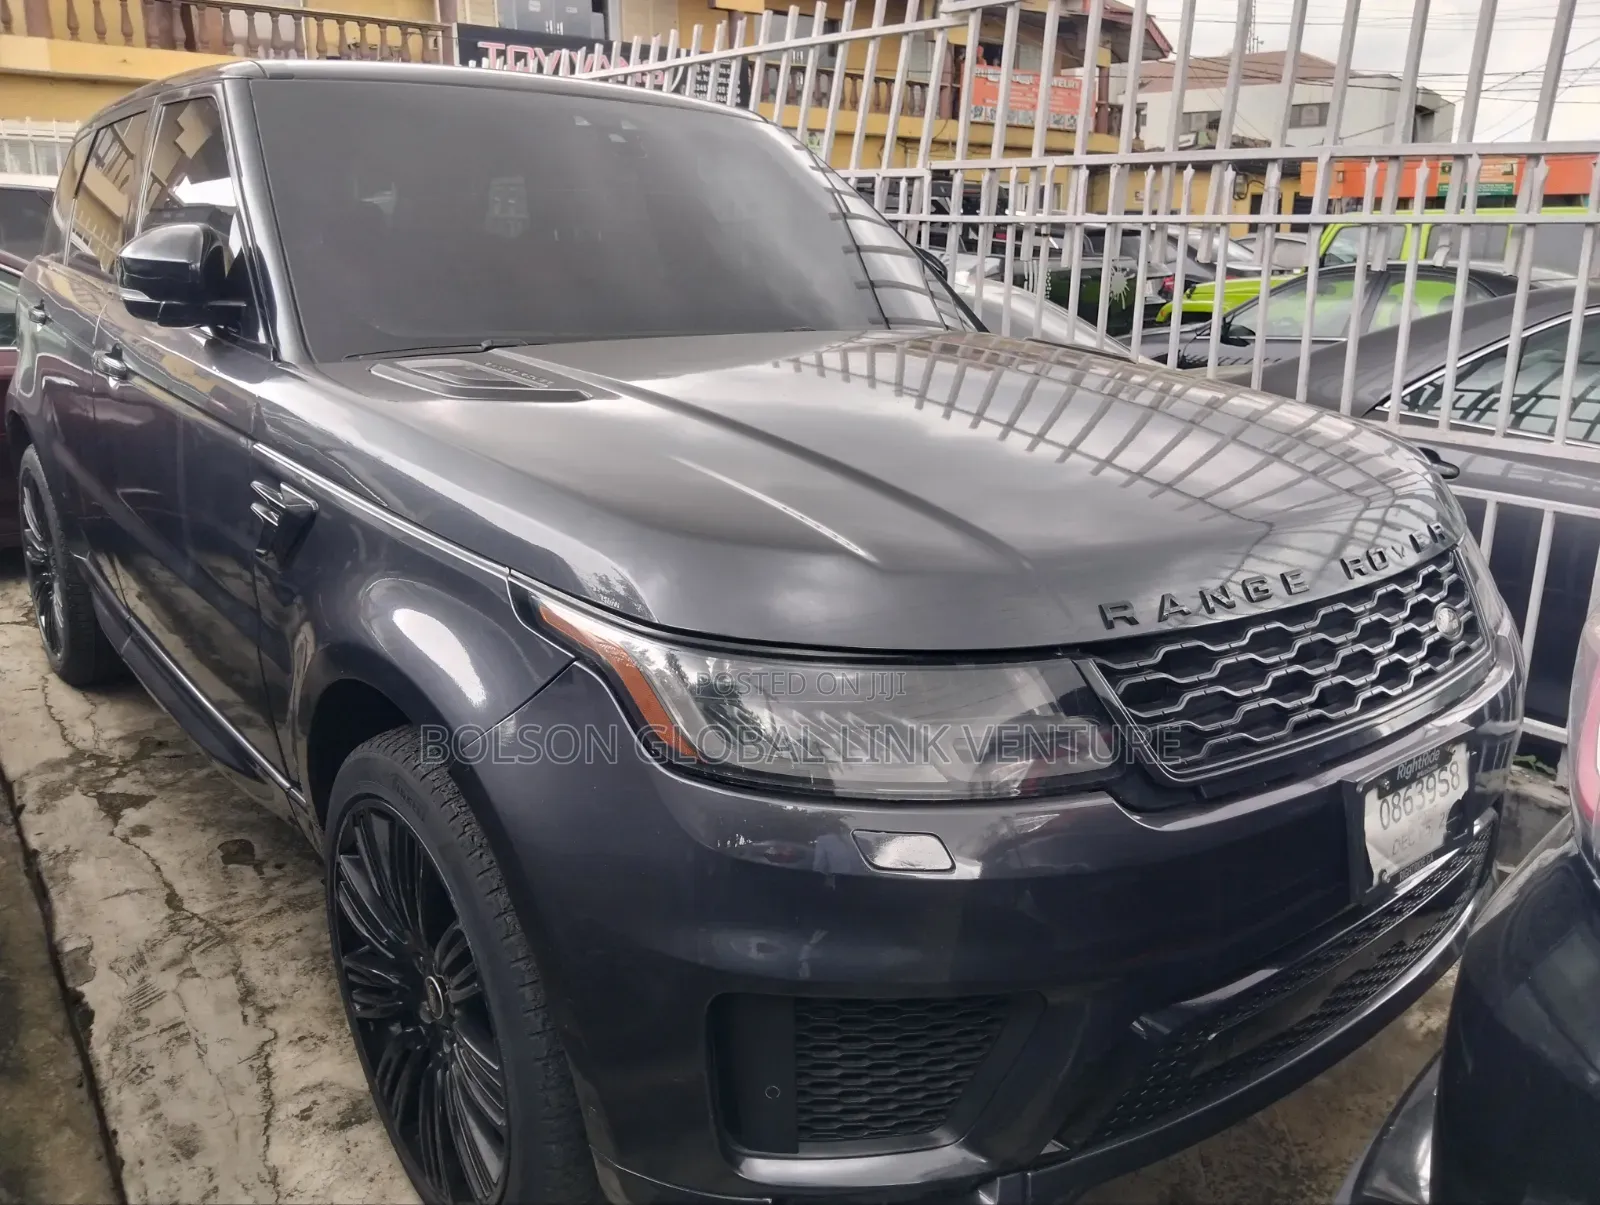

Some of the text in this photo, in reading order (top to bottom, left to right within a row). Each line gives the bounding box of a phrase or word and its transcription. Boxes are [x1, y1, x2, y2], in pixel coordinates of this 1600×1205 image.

[1097, 521, 1446, 630] RANGE ROVER
[1379, 760, 1461, 831] 0863958
